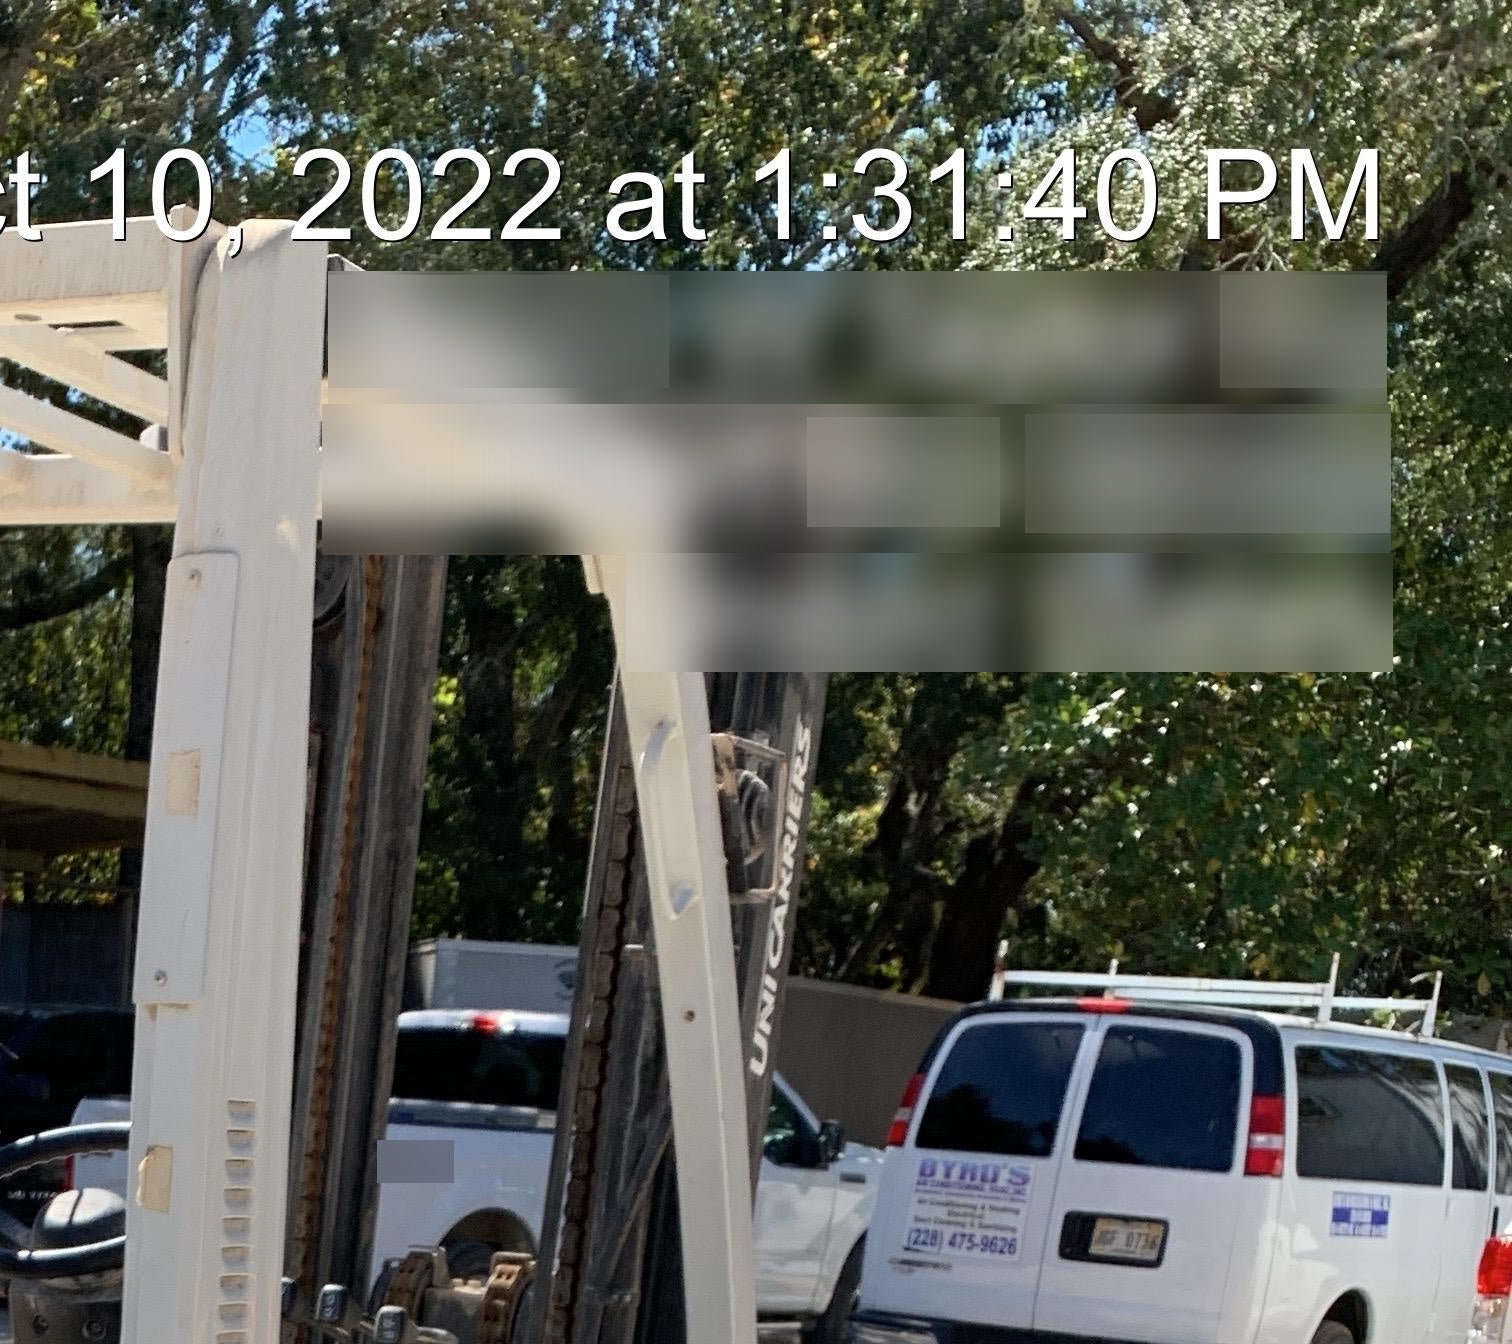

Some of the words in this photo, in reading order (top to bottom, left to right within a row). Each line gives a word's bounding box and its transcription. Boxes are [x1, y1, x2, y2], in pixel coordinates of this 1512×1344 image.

[919, 1158, 1032, 1186] BYRD'S
[907, 1227, 944, 1250] (228)
[948, 1231, 1017, 1256] 475-9626
